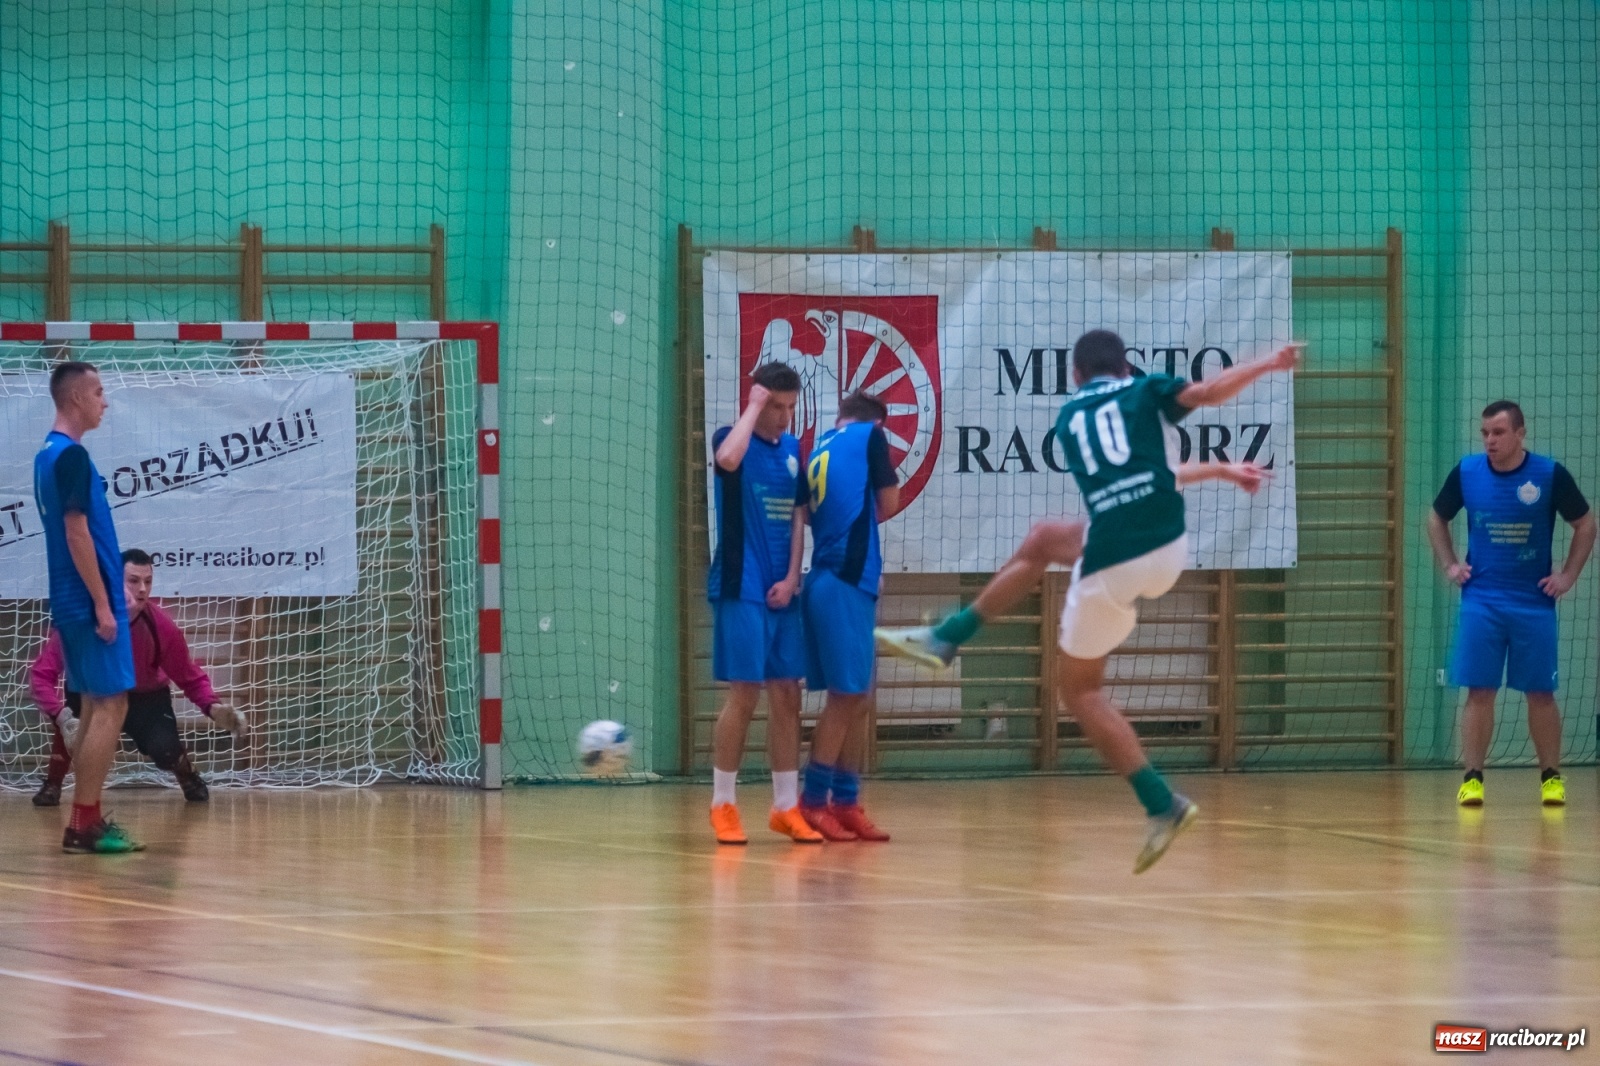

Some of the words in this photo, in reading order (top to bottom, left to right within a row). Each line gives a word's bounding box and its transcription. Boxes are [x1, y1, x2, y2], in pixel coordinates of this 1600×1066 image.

[993, 347, 1233, 396] MISTO
[100, 408, 319, 498] ORZĄDKU!
[1068, 400, 1131, 476] 10
[807, 450, 830, 513] 9
